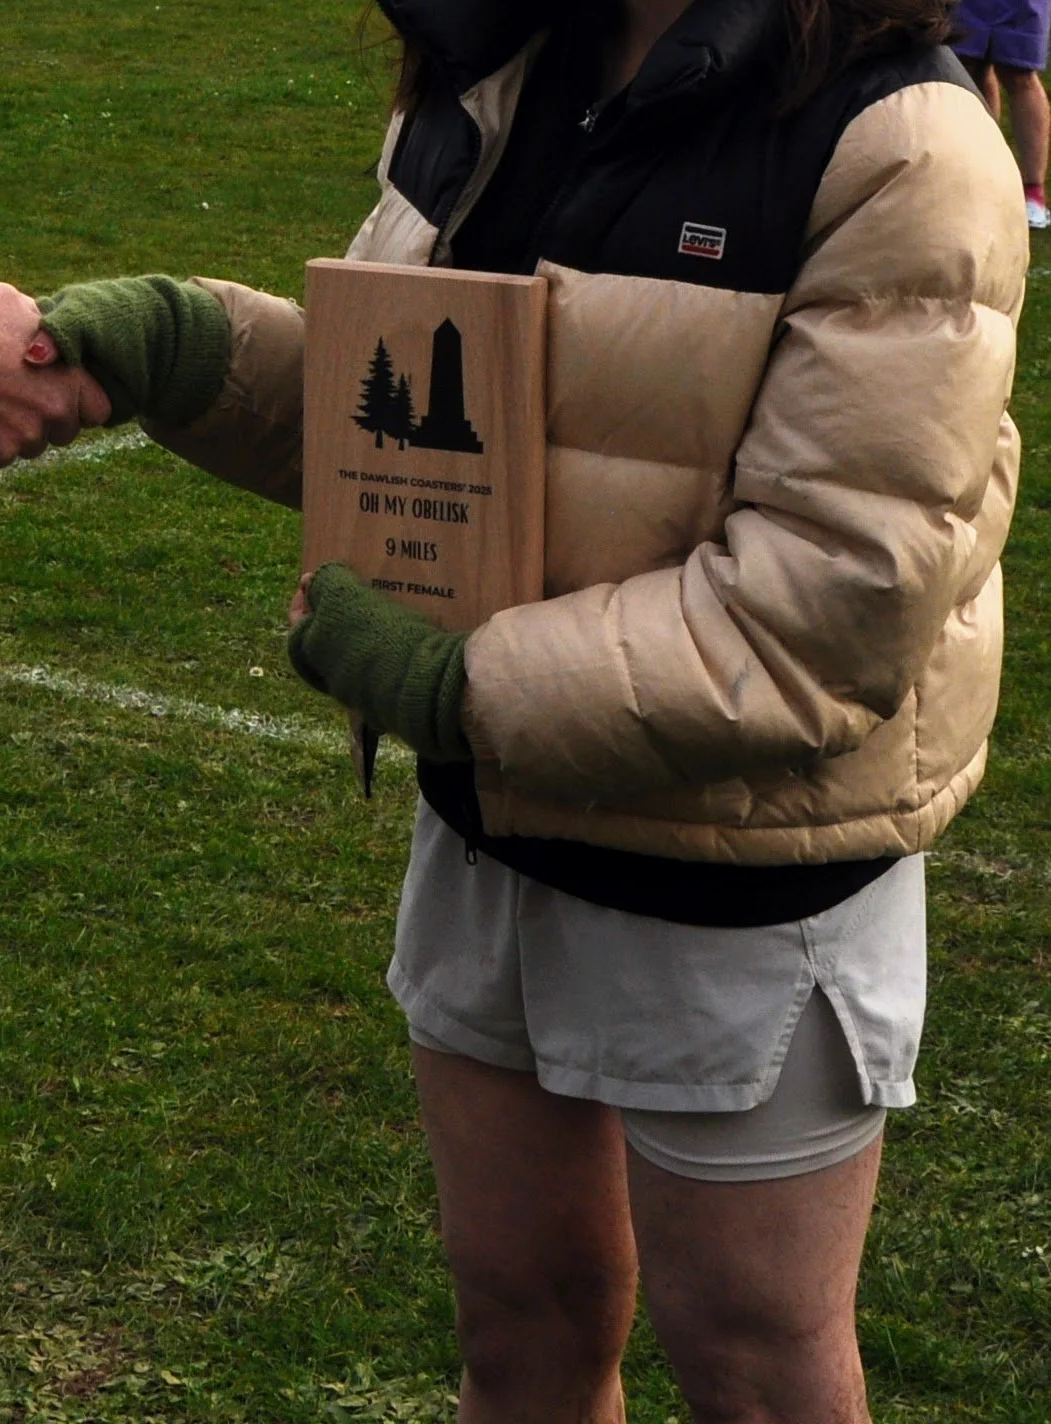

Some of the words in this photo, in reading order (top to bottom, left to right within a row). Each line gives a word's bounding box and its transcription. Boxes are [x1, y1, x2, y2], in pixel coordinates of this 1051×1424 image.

[339, 469, 358, 480] THE
[360, 472, 407, 486] DAWLISH
[468, 484, 492, 495] 2025
[359, 492, 379, 514] OH
[385, 494, 407, 516] MY
[412, 498, 469, 524] OBELISK
[386, 537, 396, 556] 9
[401, 539, 438, 561] MILES
[371, 578, 404, 592] FIRST
[407, 583, 455, 599] FEMALE
